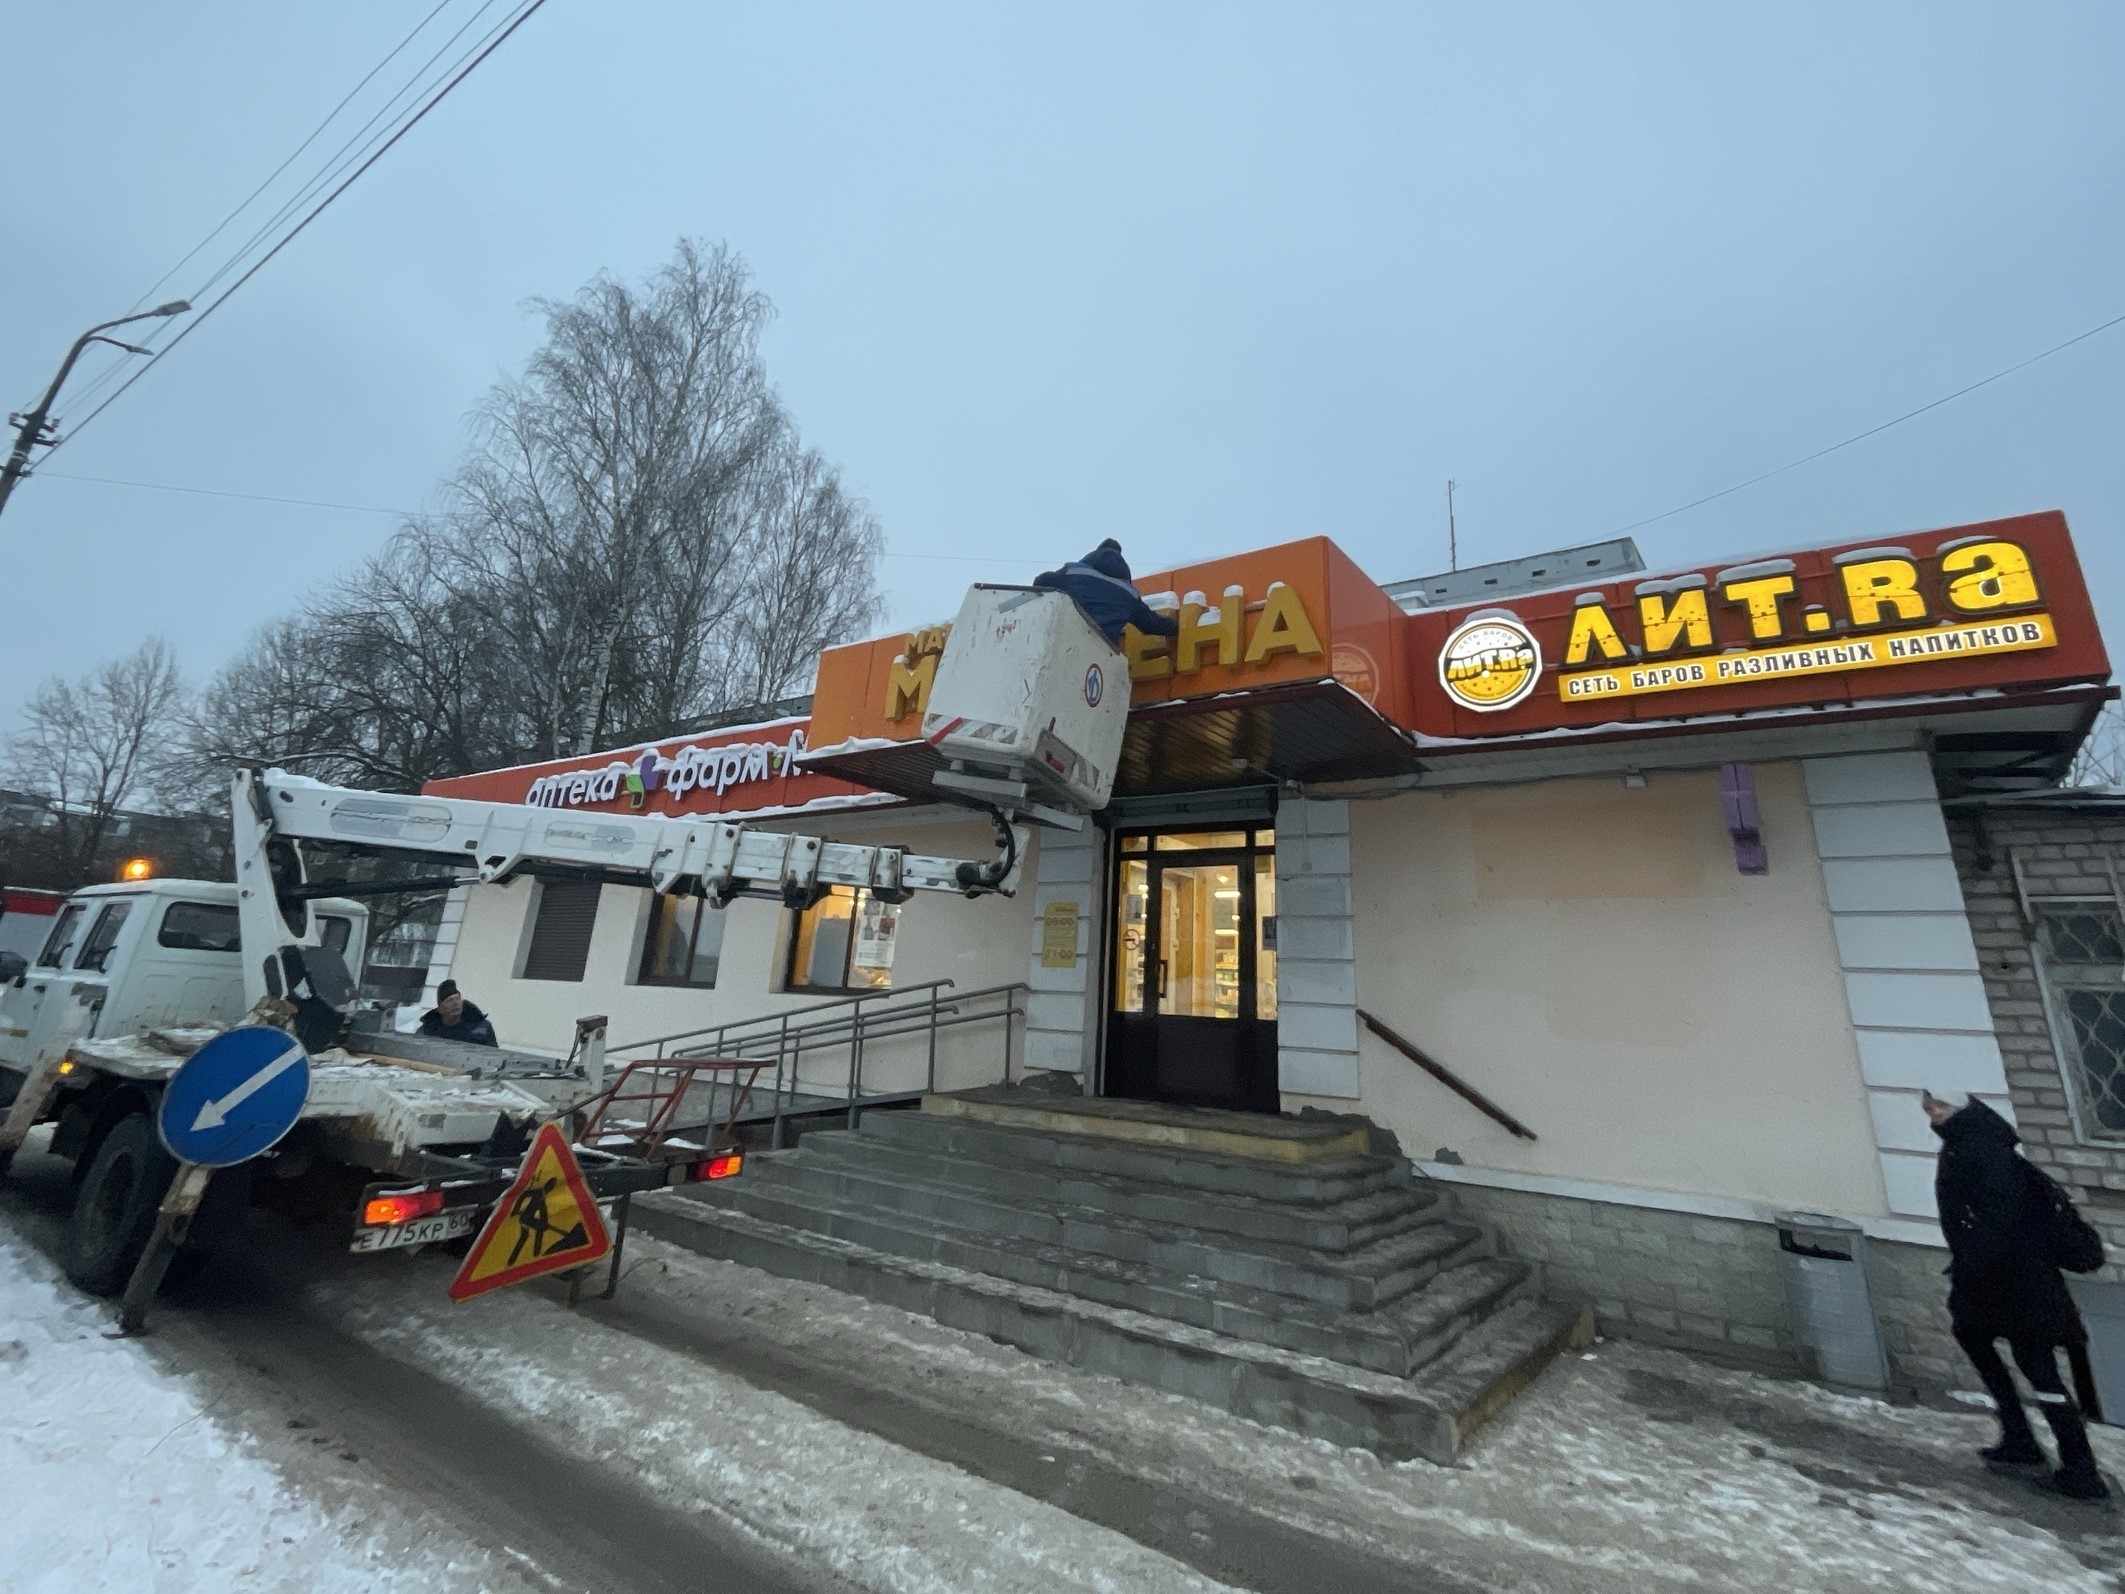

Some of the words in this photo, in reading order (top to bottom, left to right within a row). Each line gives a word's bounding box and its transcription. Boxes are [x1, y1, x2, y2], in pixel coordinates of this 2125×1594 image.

[1567, 676, 1619, 696] СЕТЬ
[1632, 665, 1704, 688] БАРОВ
[1718, 643, 1874, 678] РАЗЛИВНЫХ
[1889, 622, 2041, 657] НАПИТКОВ
[525, 768, 620, 806] аптека
